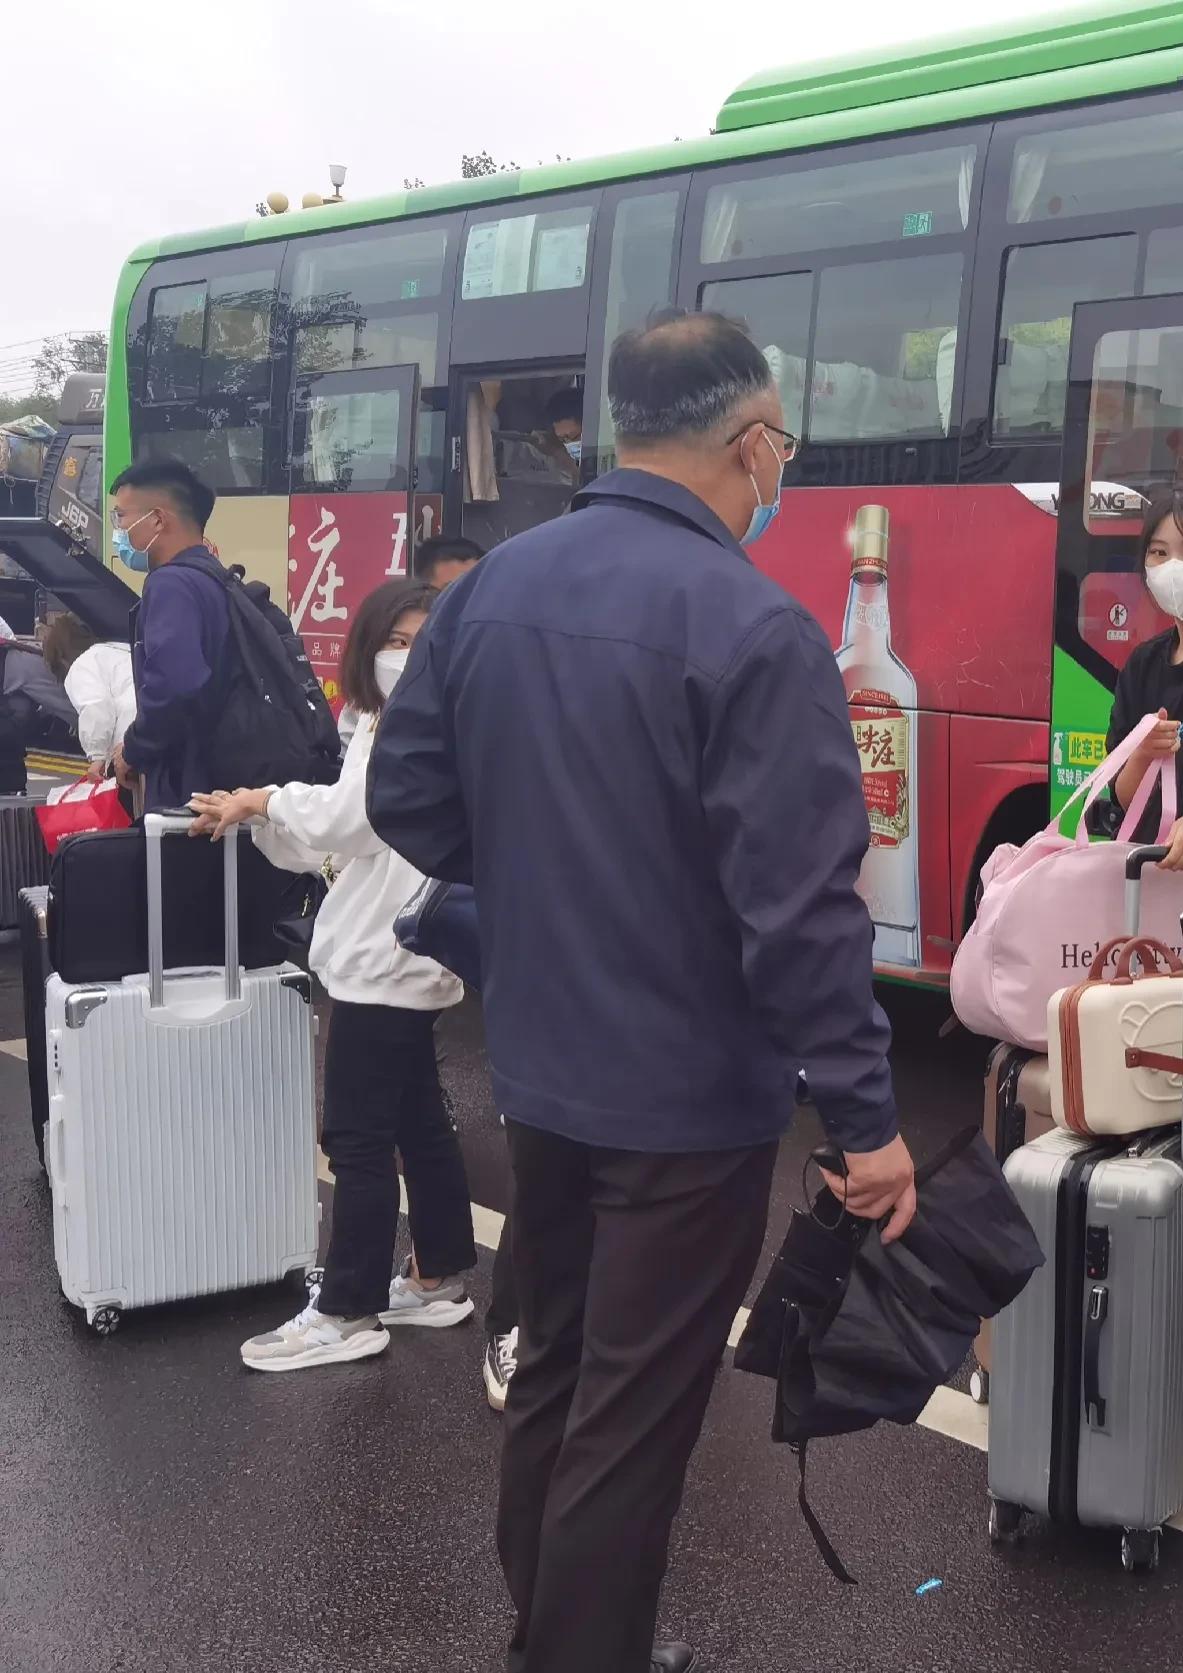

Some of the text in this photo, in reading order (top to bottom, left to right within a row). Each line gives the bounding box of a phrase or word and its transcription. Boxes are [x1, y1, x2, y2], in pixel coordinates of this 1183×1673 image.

[62, 501, 89, 529] J6P
[857, 723, 896, 769] 尖庄
[1057, 767, 1090, 786] 驾驶员
